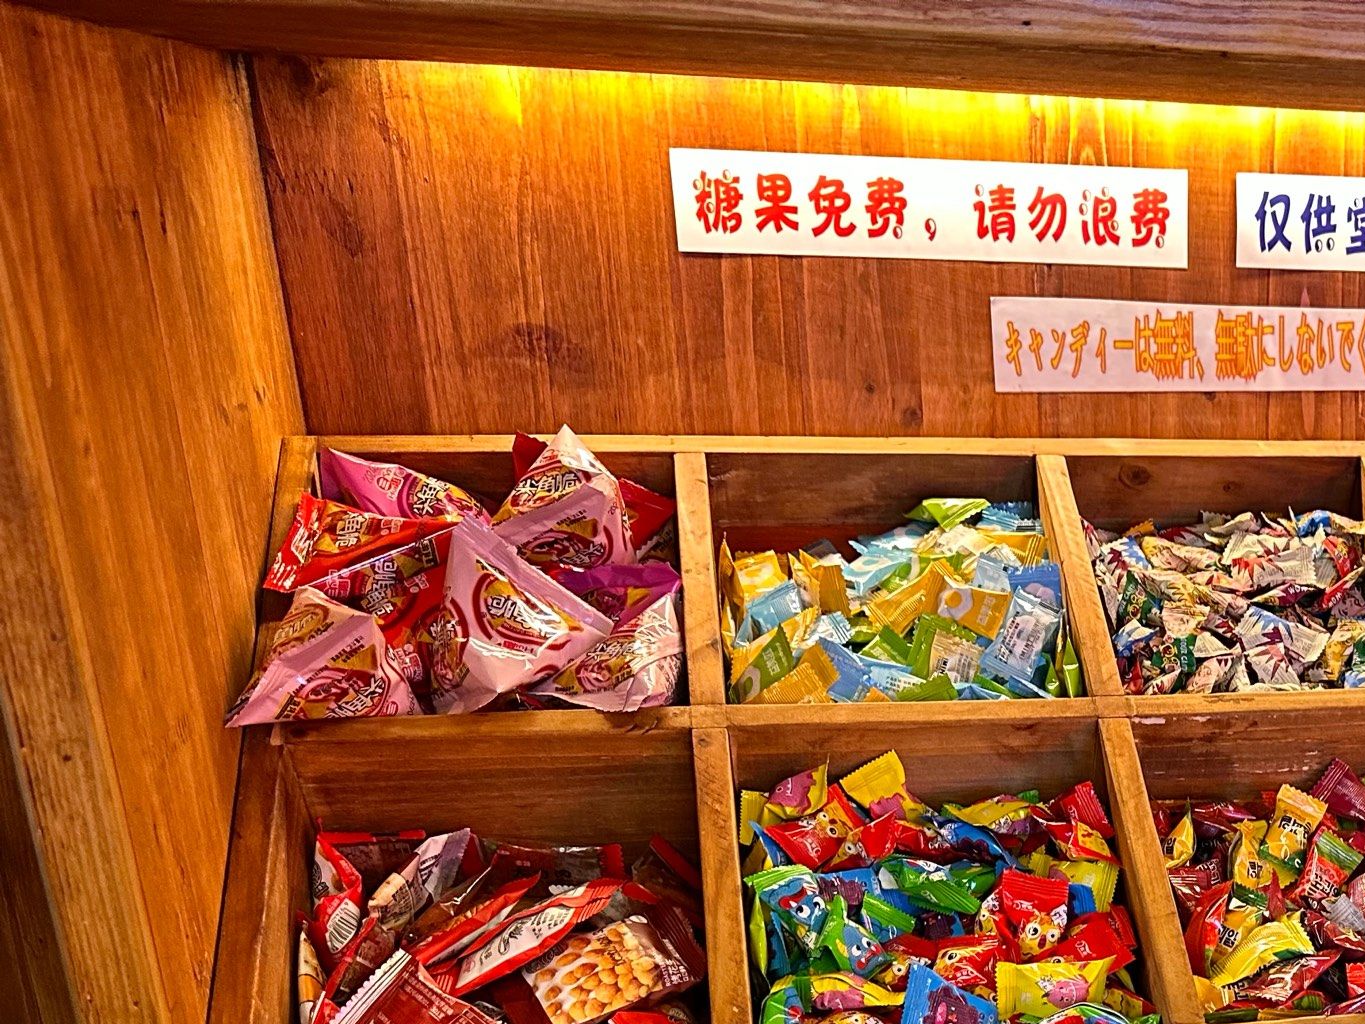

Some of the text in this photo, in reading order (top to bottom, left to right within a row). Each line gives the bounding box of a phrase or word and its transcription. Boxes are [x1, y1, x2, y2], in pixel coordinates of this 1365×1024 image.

[692, 169, 1170, 249] 糖果免费，请勿浪费
